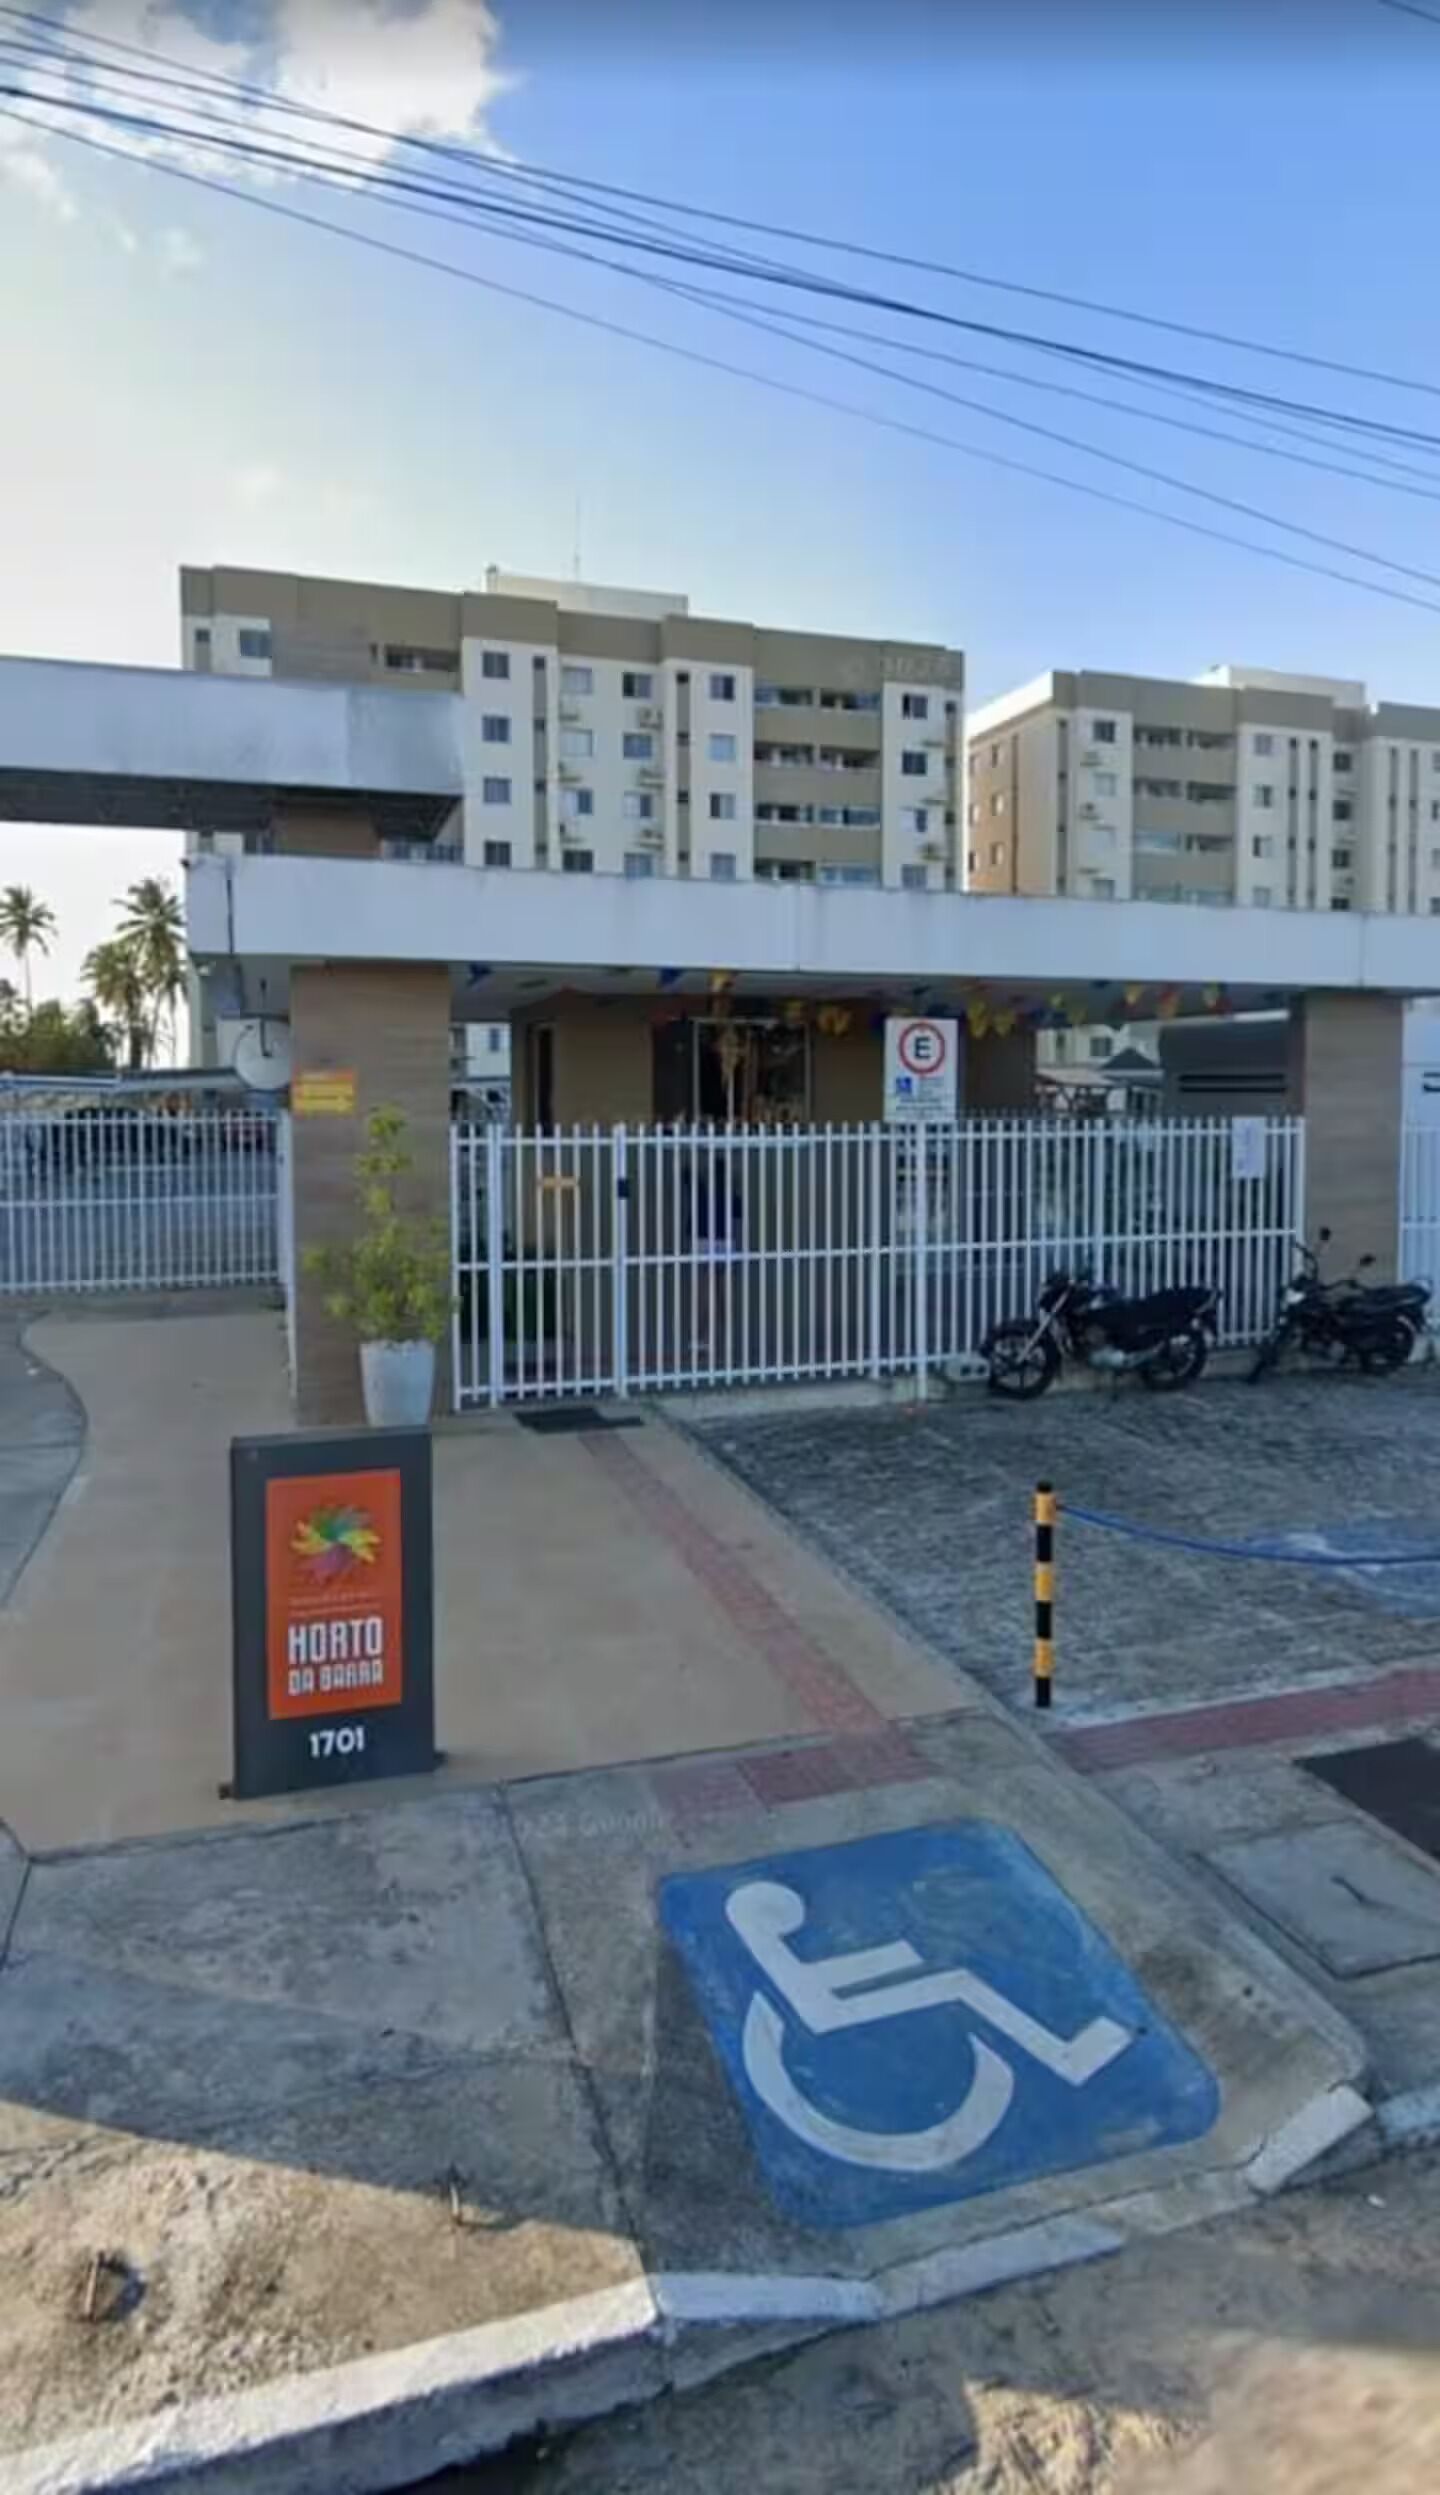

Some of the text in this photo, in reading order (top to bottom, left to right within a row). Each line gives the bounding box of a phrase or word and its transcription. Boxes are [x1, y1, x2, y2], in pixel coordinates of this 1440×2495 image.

[914, 1036, 931, 1060] E
[287, 1616, 383, 1665] HORTO
[288, 1659, 383, 1696] DA BARRA
[310, 1726, 365, 1758] 1701
